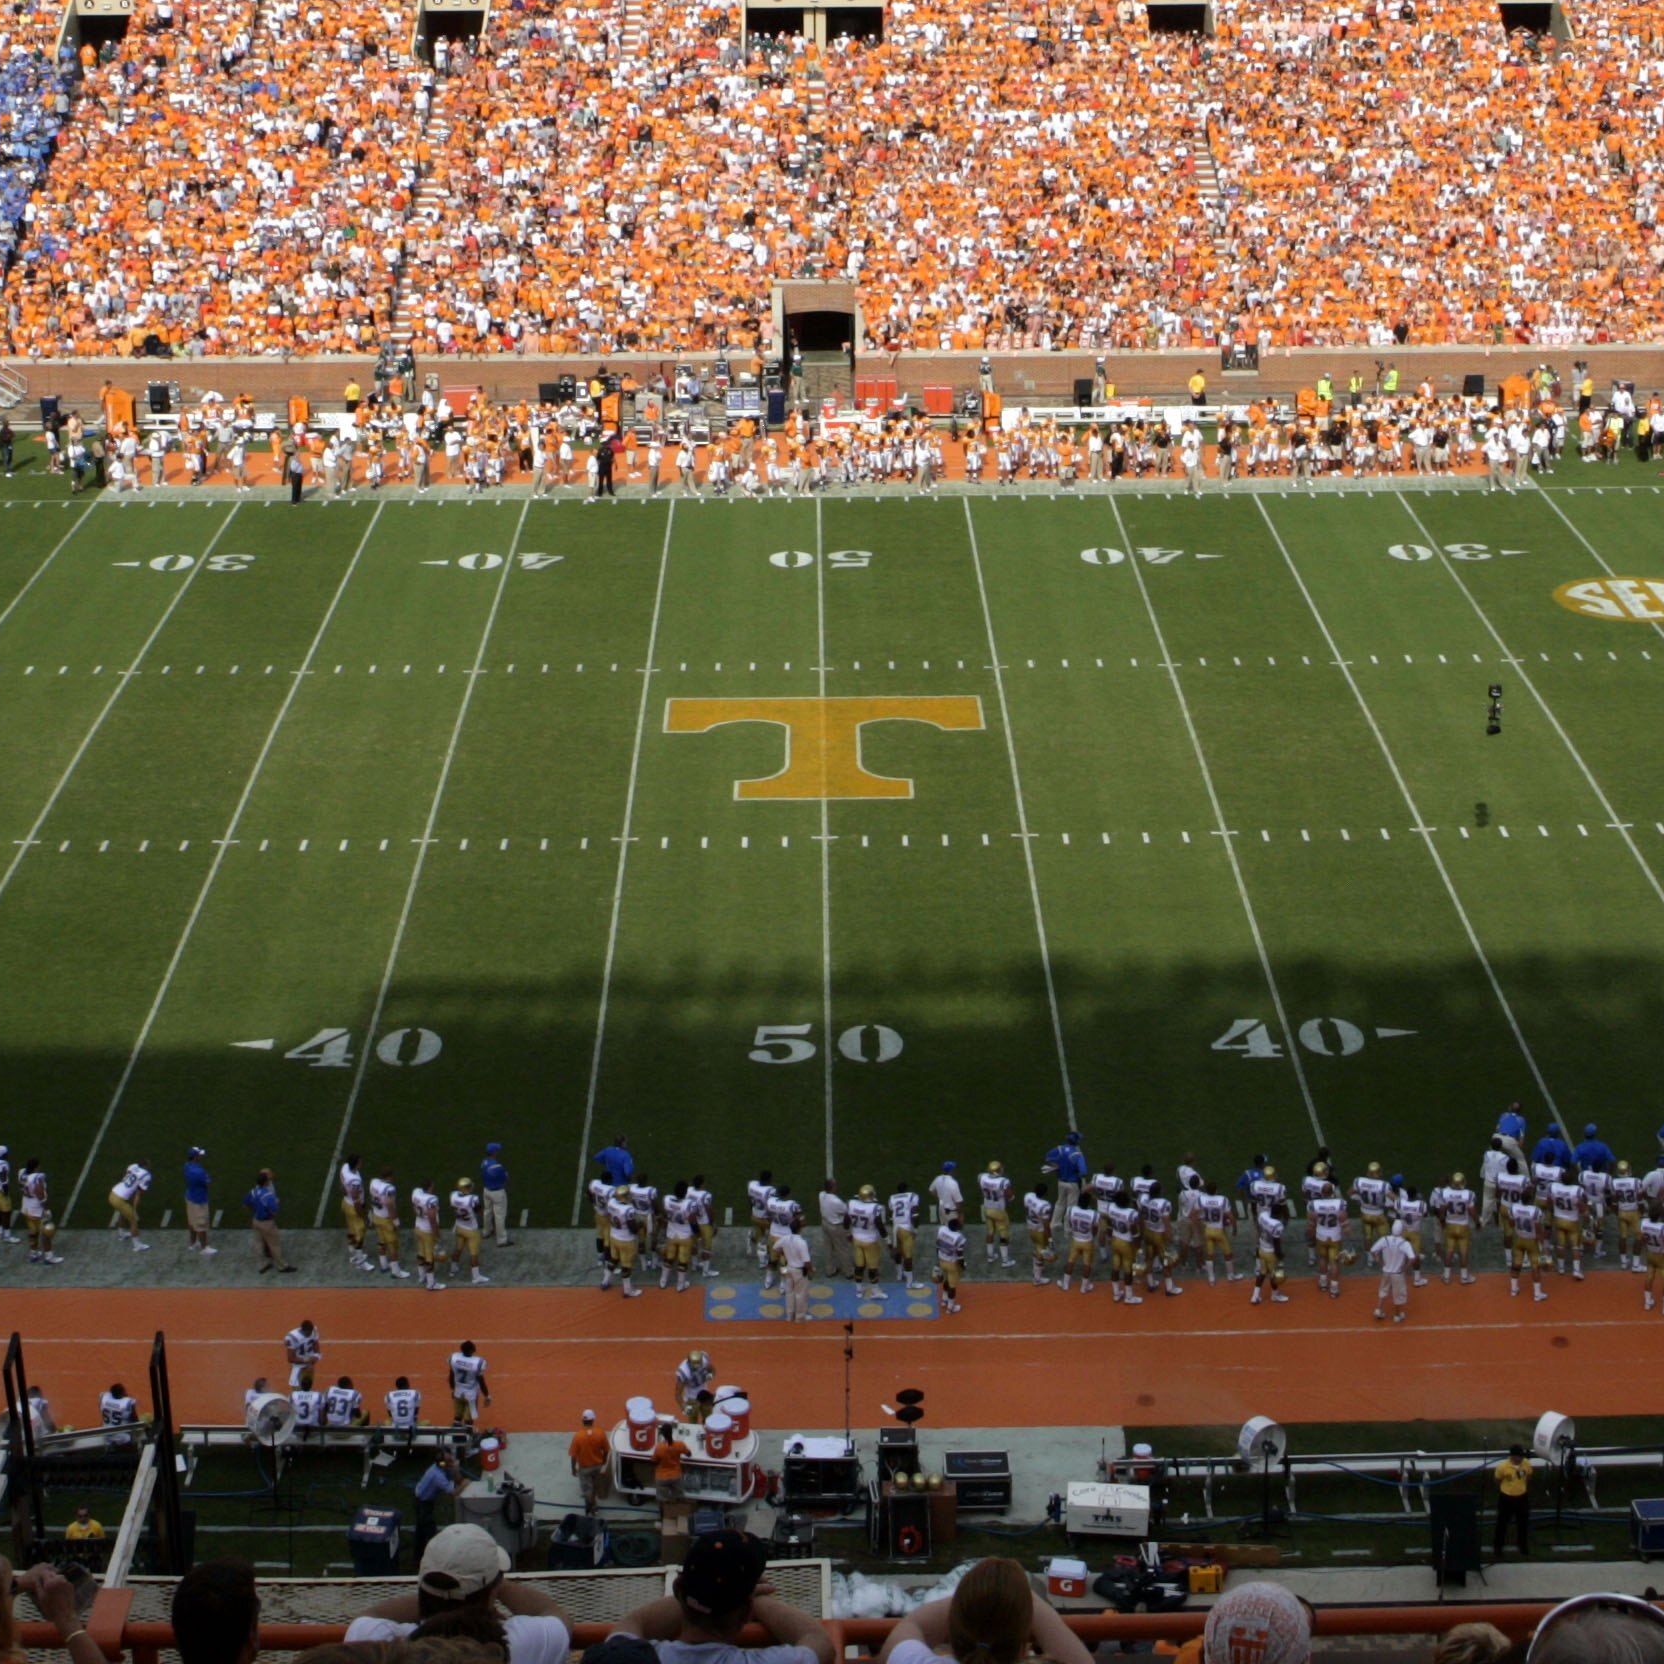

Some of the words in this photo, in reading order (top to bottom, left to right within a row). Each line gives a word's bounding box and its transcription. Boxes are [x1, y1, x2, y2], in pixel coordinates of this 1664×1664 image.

[662, 695, 984, 800] T
[284, 1026, 442, 1067] 40
[748, 1023, 904, 1065] 50
[1211, 1017, 1365, 1059] 40
[895, 1201, 905, 1218] 2
[1556, 1197, 1572, 1211] 61
[1318, 1213, 1338, 1228] 72
[299, 1402, 310, 1419] 3
[397, 1399, 408, 1417] 6
[635, 1429, 648, 1442] G
[711, 1438, 723, 1450] G
[487, 1453, 496, 1463] G
[1059, 1579, 1073, 1592] G
